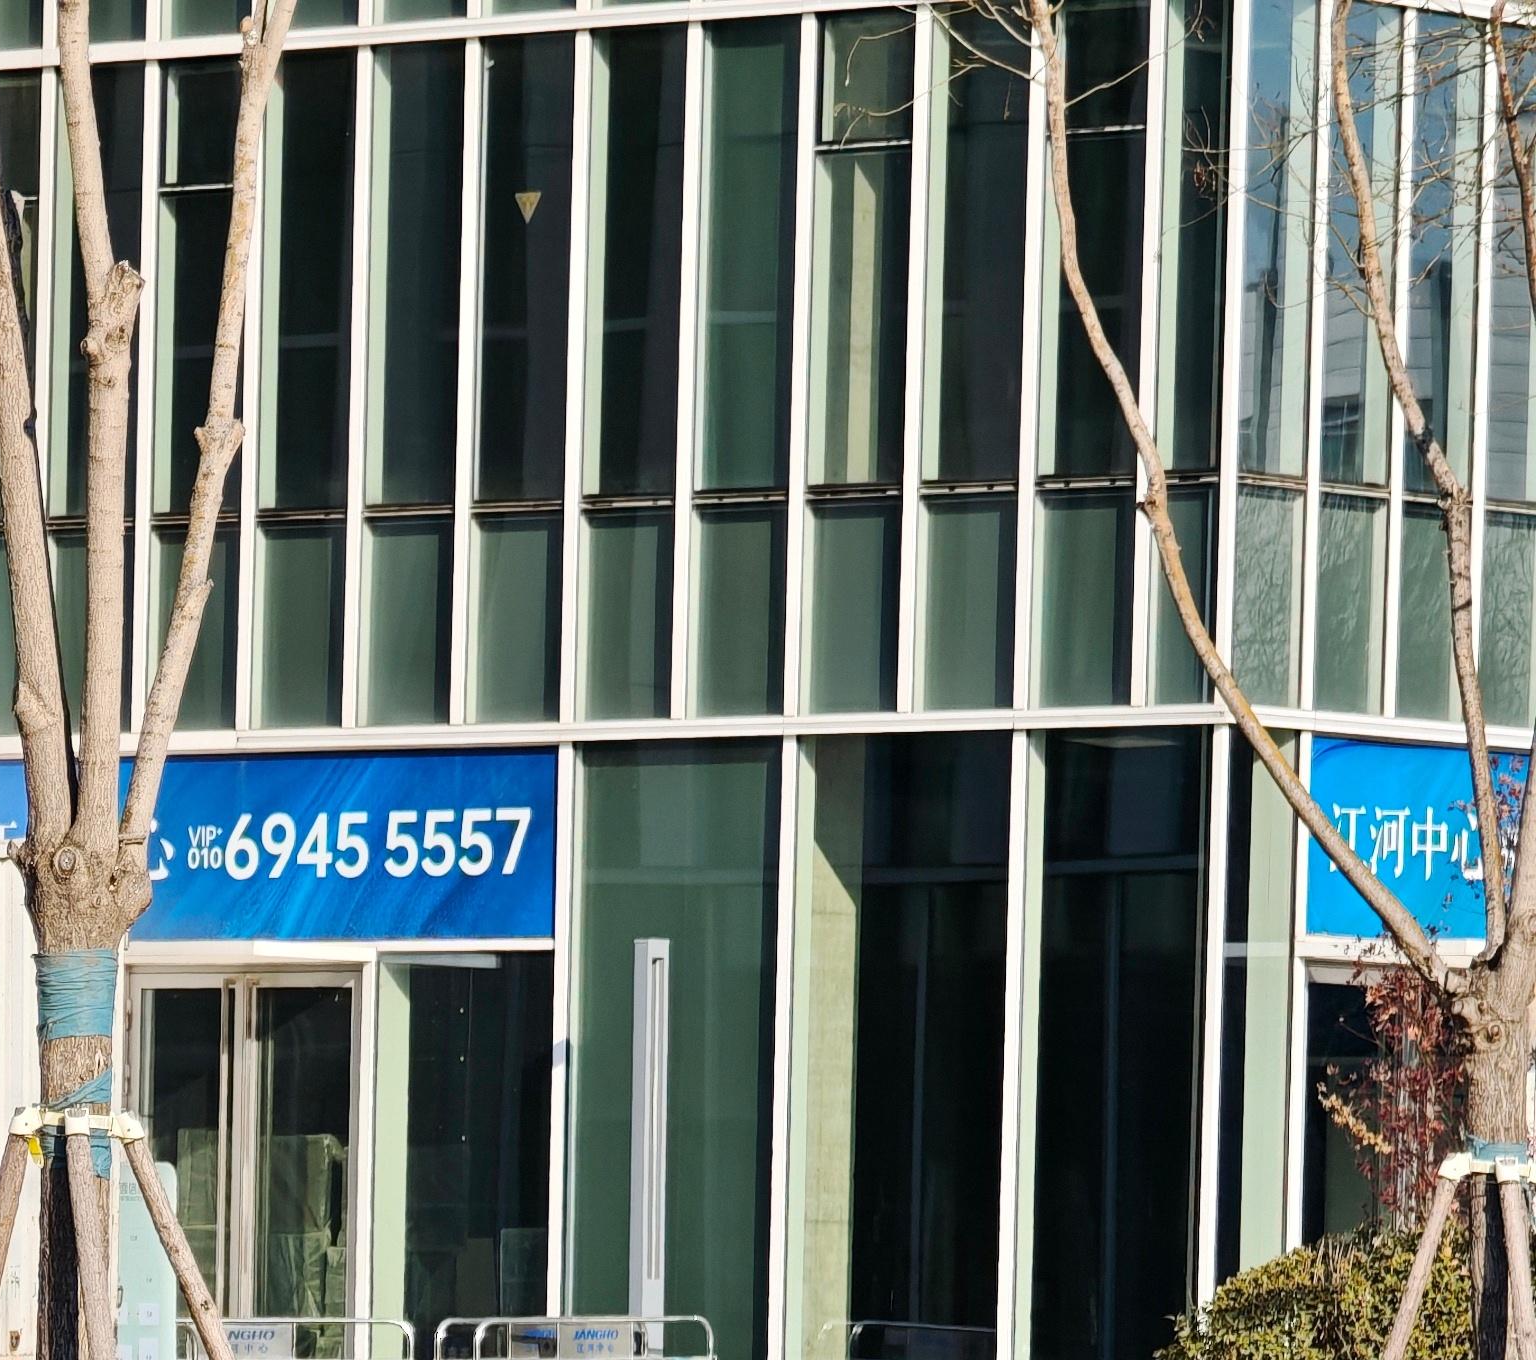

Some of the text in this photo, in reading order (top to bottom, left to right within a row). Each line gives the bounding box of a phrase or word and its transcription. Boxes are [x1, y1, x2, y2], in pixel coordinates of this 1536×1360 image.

[188, 825, 216, 848] VIP
[224, 811, 370, 881] 6945
[383, 806, 532, 878] 5557
[187, 847, 223, 870] 010
